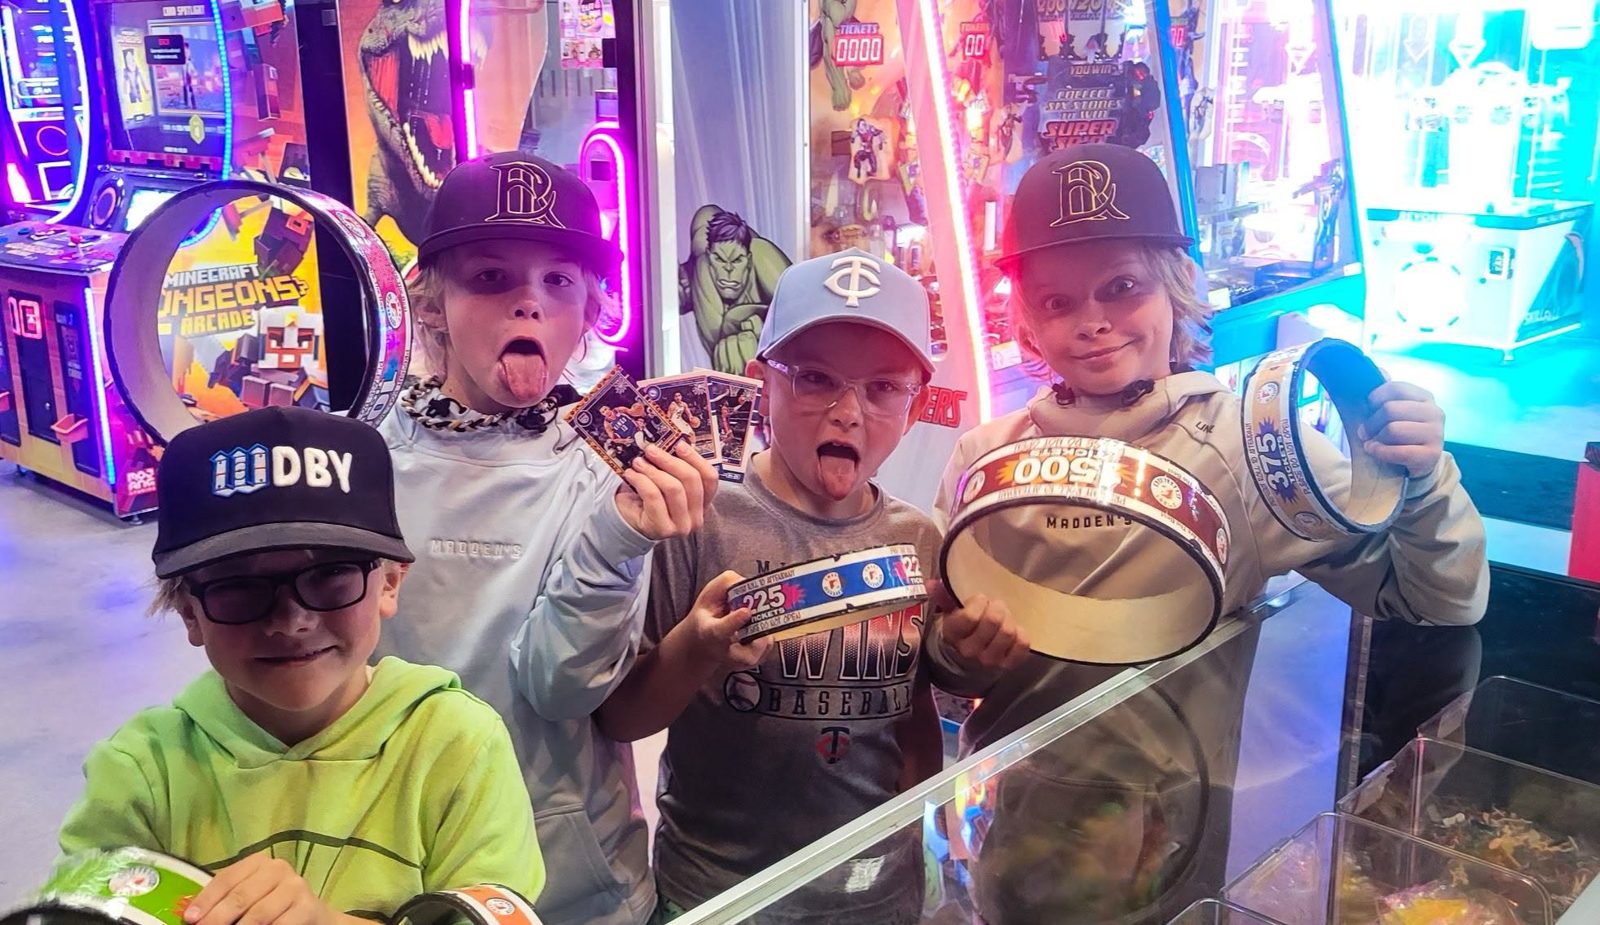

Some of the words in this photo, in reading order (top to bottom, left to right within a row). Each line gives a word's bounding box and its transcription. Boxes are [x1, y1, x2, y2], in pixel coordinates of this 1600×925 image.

[836, 38, 882, 61] 0000
[965, 34, 985, 56] 00
[1043, 120, 1116, 137] SUPER
[164, 263, 260, 288] MINECRAFT
[157, 274, 301, 318] UNGEONS
[180, 309, 256, 336] ARCADE
[918, 385, 968, 428] ERS
[1013, 457, 1100, 485] 500
[1255, 433, 1290, 491] 375
[1277, 435, 1296, 484] TICKETS
[429, 537, 522, 559] MADDEN'S
[743, 584, 786, 614] 225
[777, 603, 924, 682] WINS
[769, 685, 912, 716] BASEBALL
